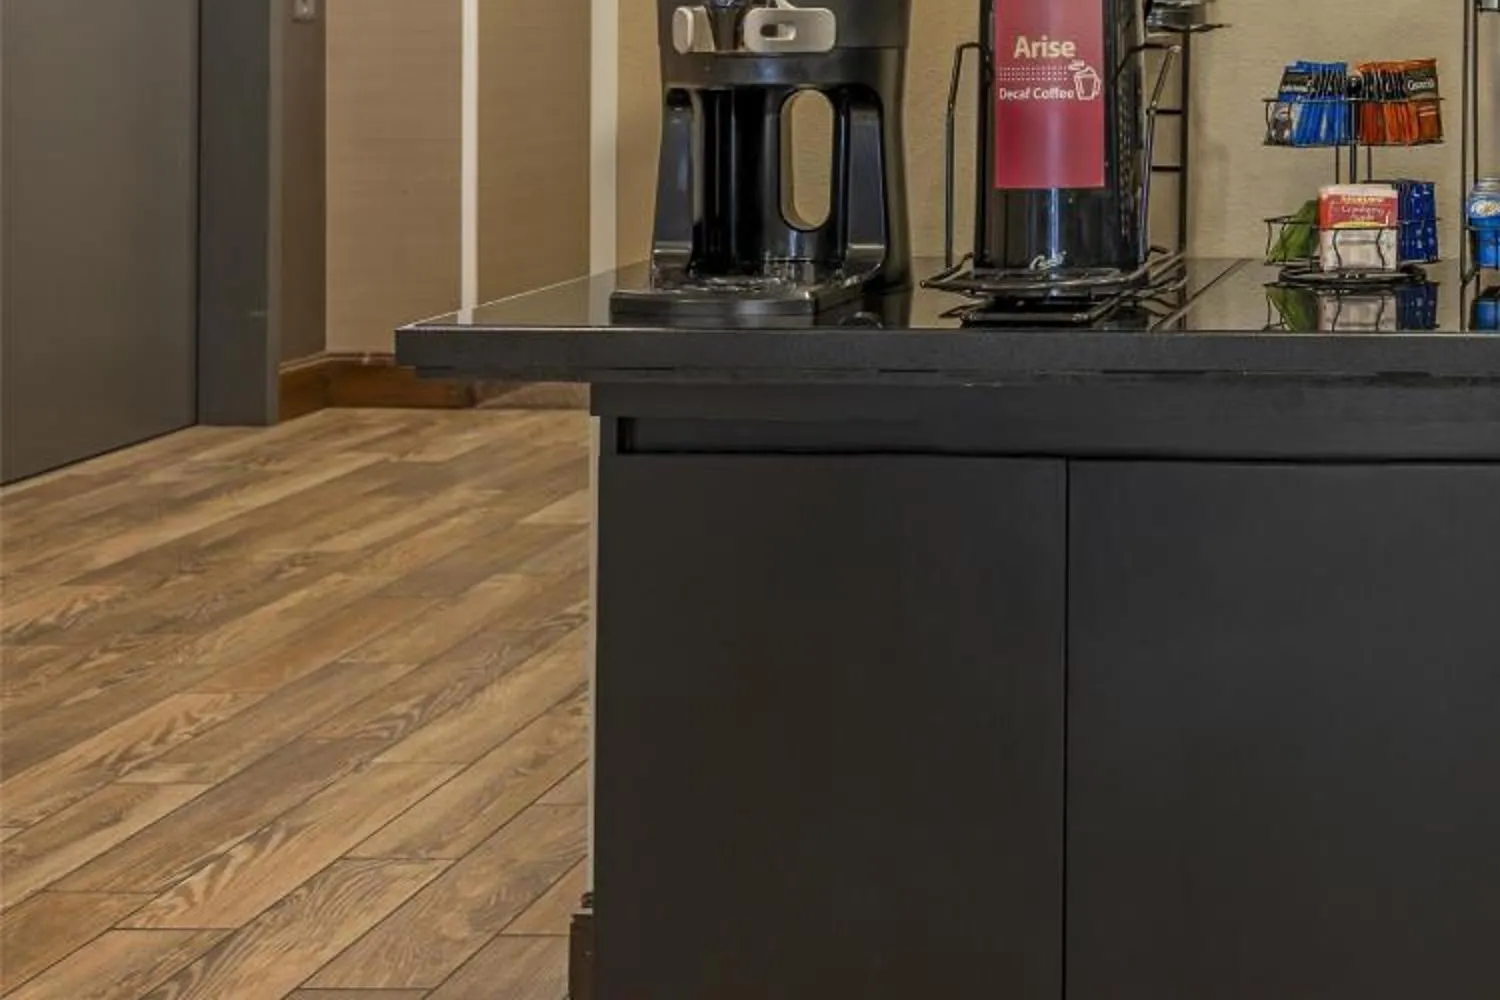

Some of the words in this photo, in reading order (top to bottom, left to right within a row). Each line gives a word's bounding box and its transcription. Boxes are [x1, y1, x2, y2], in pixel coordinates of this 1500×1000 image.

[1013, 35, 1077, 58] Arise
[999, 87, 1031, 100] Decaf
[1033, 87, 1075, 100] Coffee
